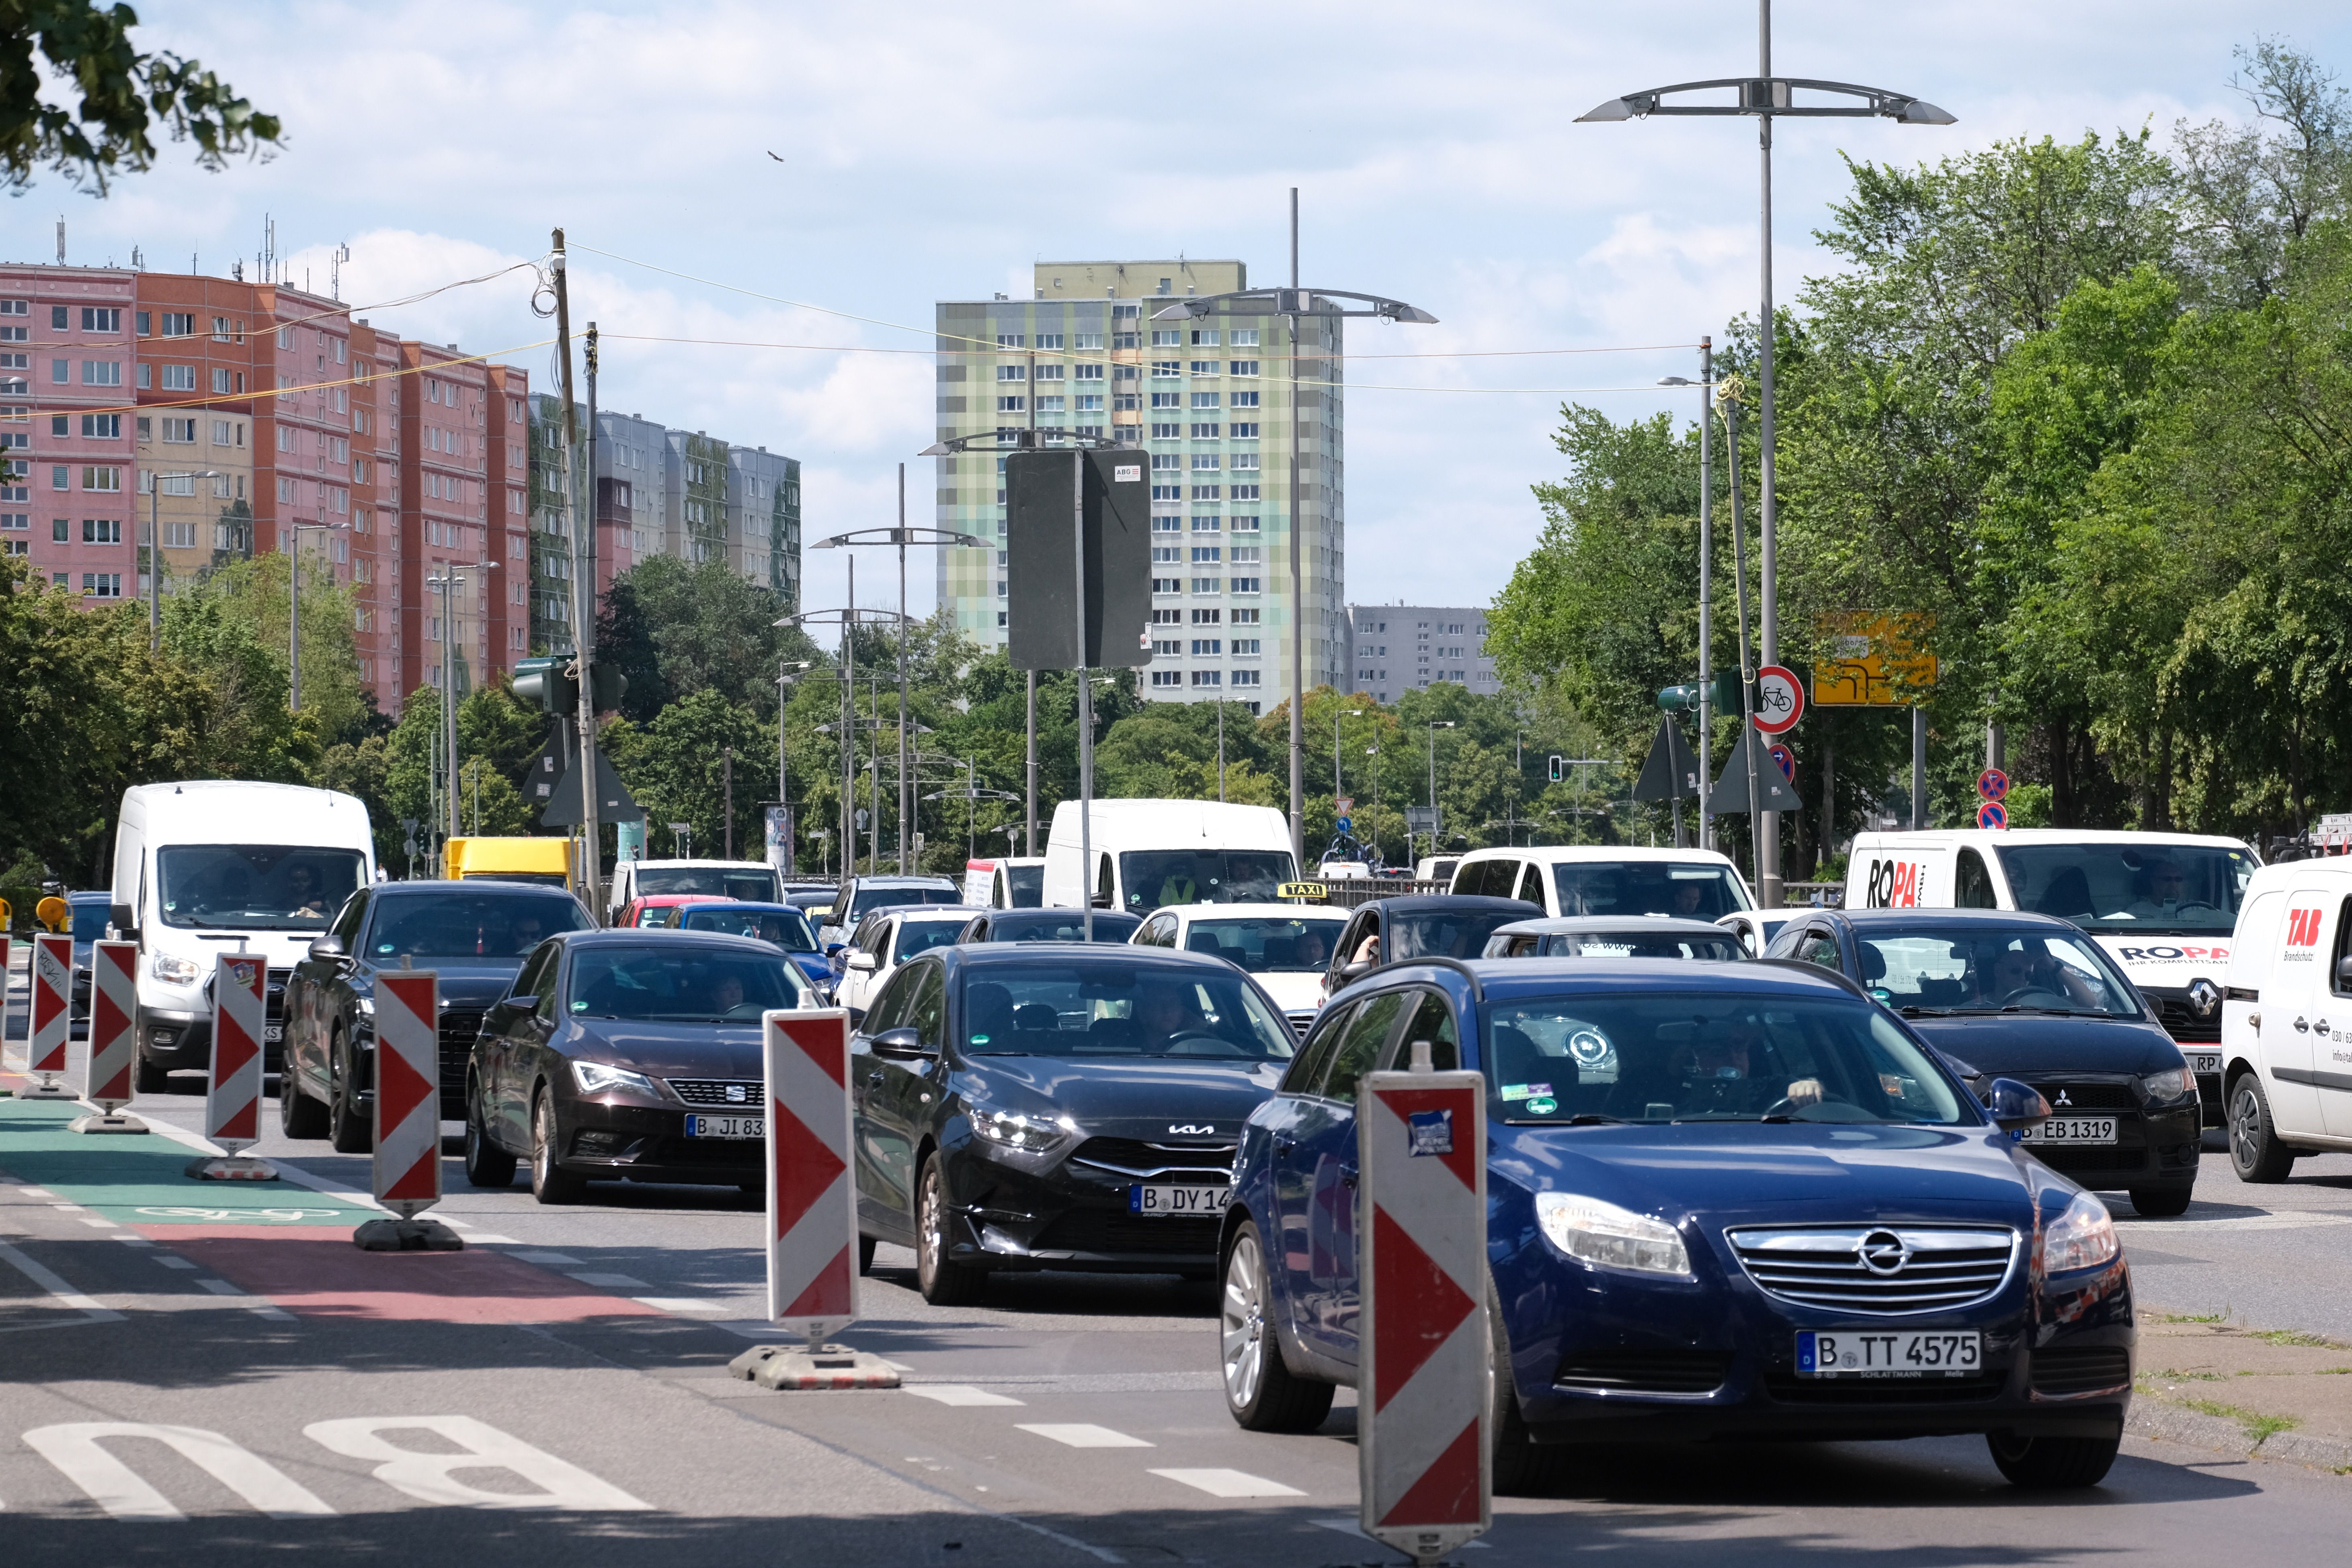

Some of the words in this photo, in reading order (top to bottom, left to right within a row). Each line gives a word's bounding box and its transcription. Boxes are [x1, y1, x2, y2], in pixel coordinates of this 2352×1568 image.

[1288, 885, 1320, 895] TAXI
[1866, 859, 1916, 908] ROPA
[2287, 909, 2322, 947] TAB
[2117, 946, 2229, 960] ROPA
[2332, 1030, 2342, 1043] 030
[2346, 1032, 2352, 1044] 63
[2198, 1057, 2215, 1071] RP
[697, 1119, 707, 1134] B
[720, 1119, 738, 1135] JI
[743, 1119, 765, 1136] 83
[2044, 1121, 2067, 1138] EB
[2070, 1121, 2112, 1138] 1319
[1144, 1189, 1157, 1209] B
[1172, 1189, 1200, 1210] DY
[1803, 1355, 1811, 1365] D
[1818, 1337, 1837, 1366] B
[1860, 1336, 1898, 1365] TT
[1906, 1336, 1977, 1365] 4575
[0, 1415, 657, 1523] BU
